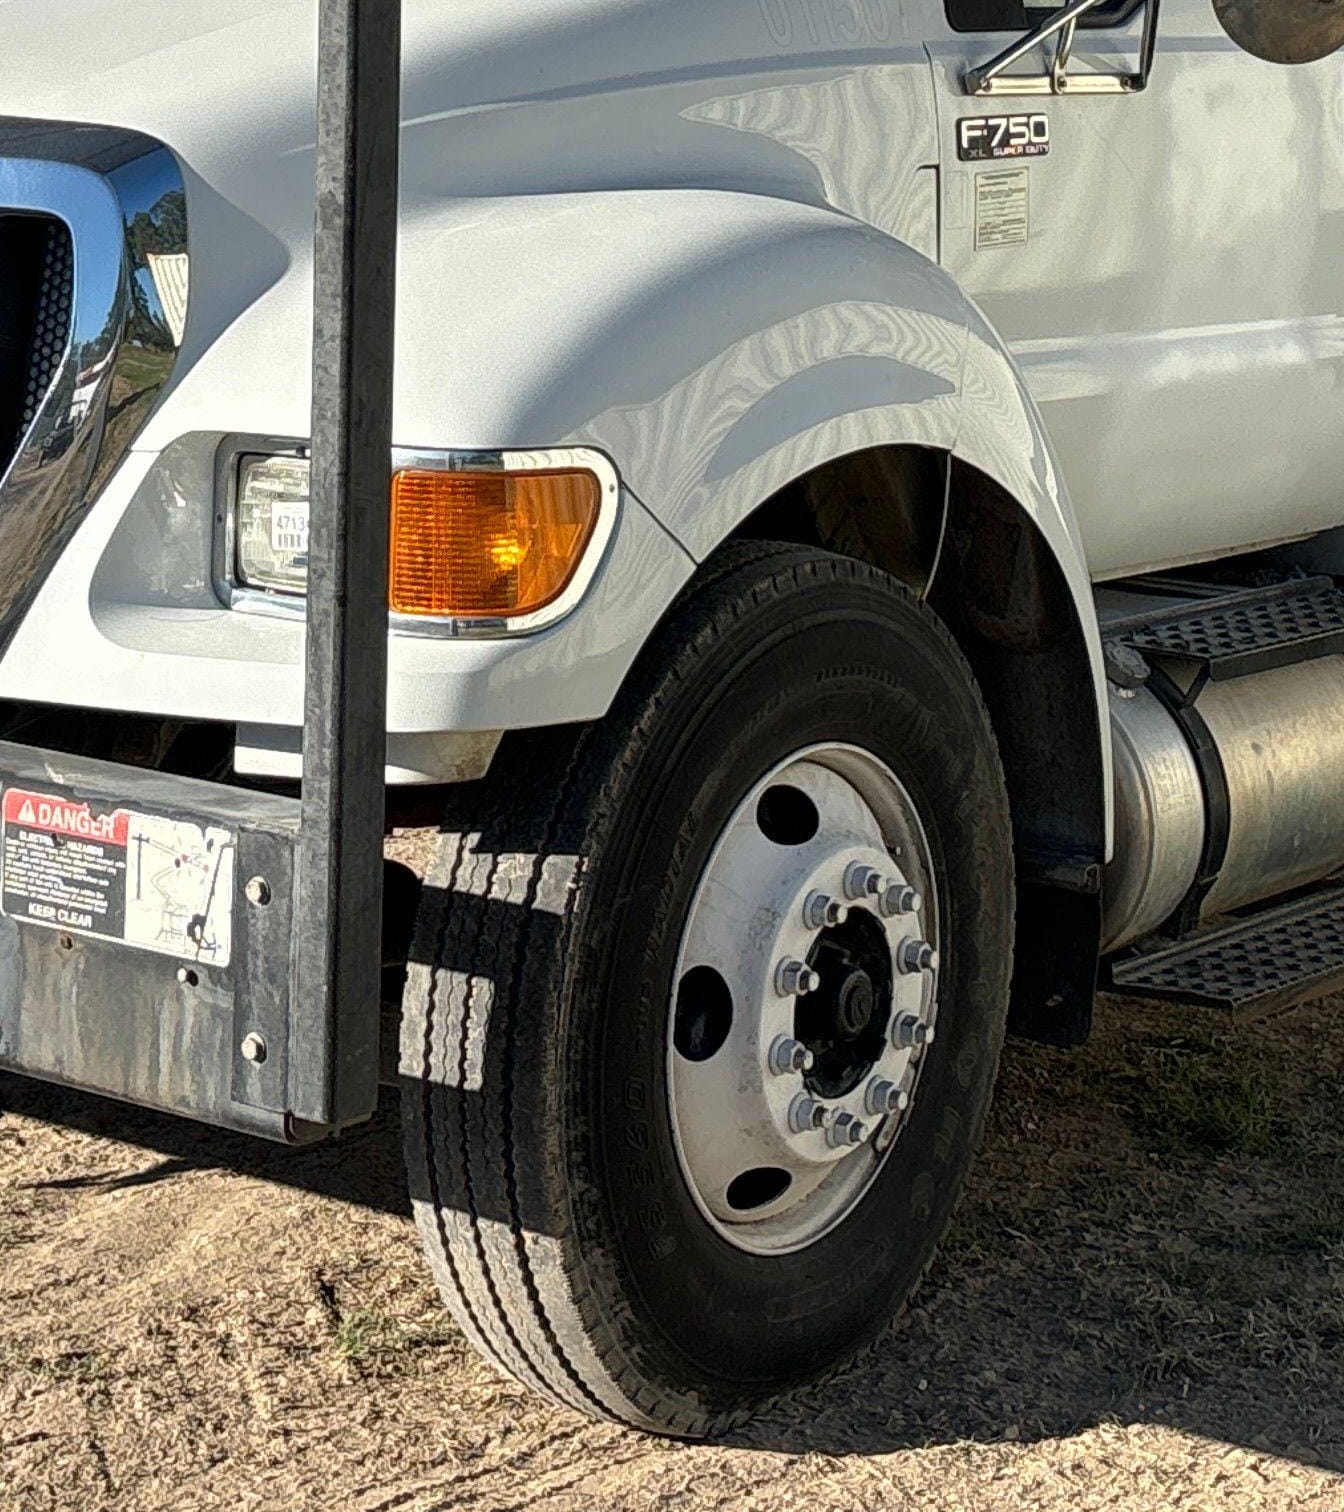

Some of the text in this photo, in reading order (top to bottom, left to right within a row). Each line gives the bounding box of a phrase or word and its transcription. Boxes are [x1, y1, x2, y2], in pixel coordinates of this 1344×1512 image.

[277, 514, 309, 532] 4713
[38, 803, 114, 838] DANGER
[28, 901, 92, 928] KEEP CLEAR
